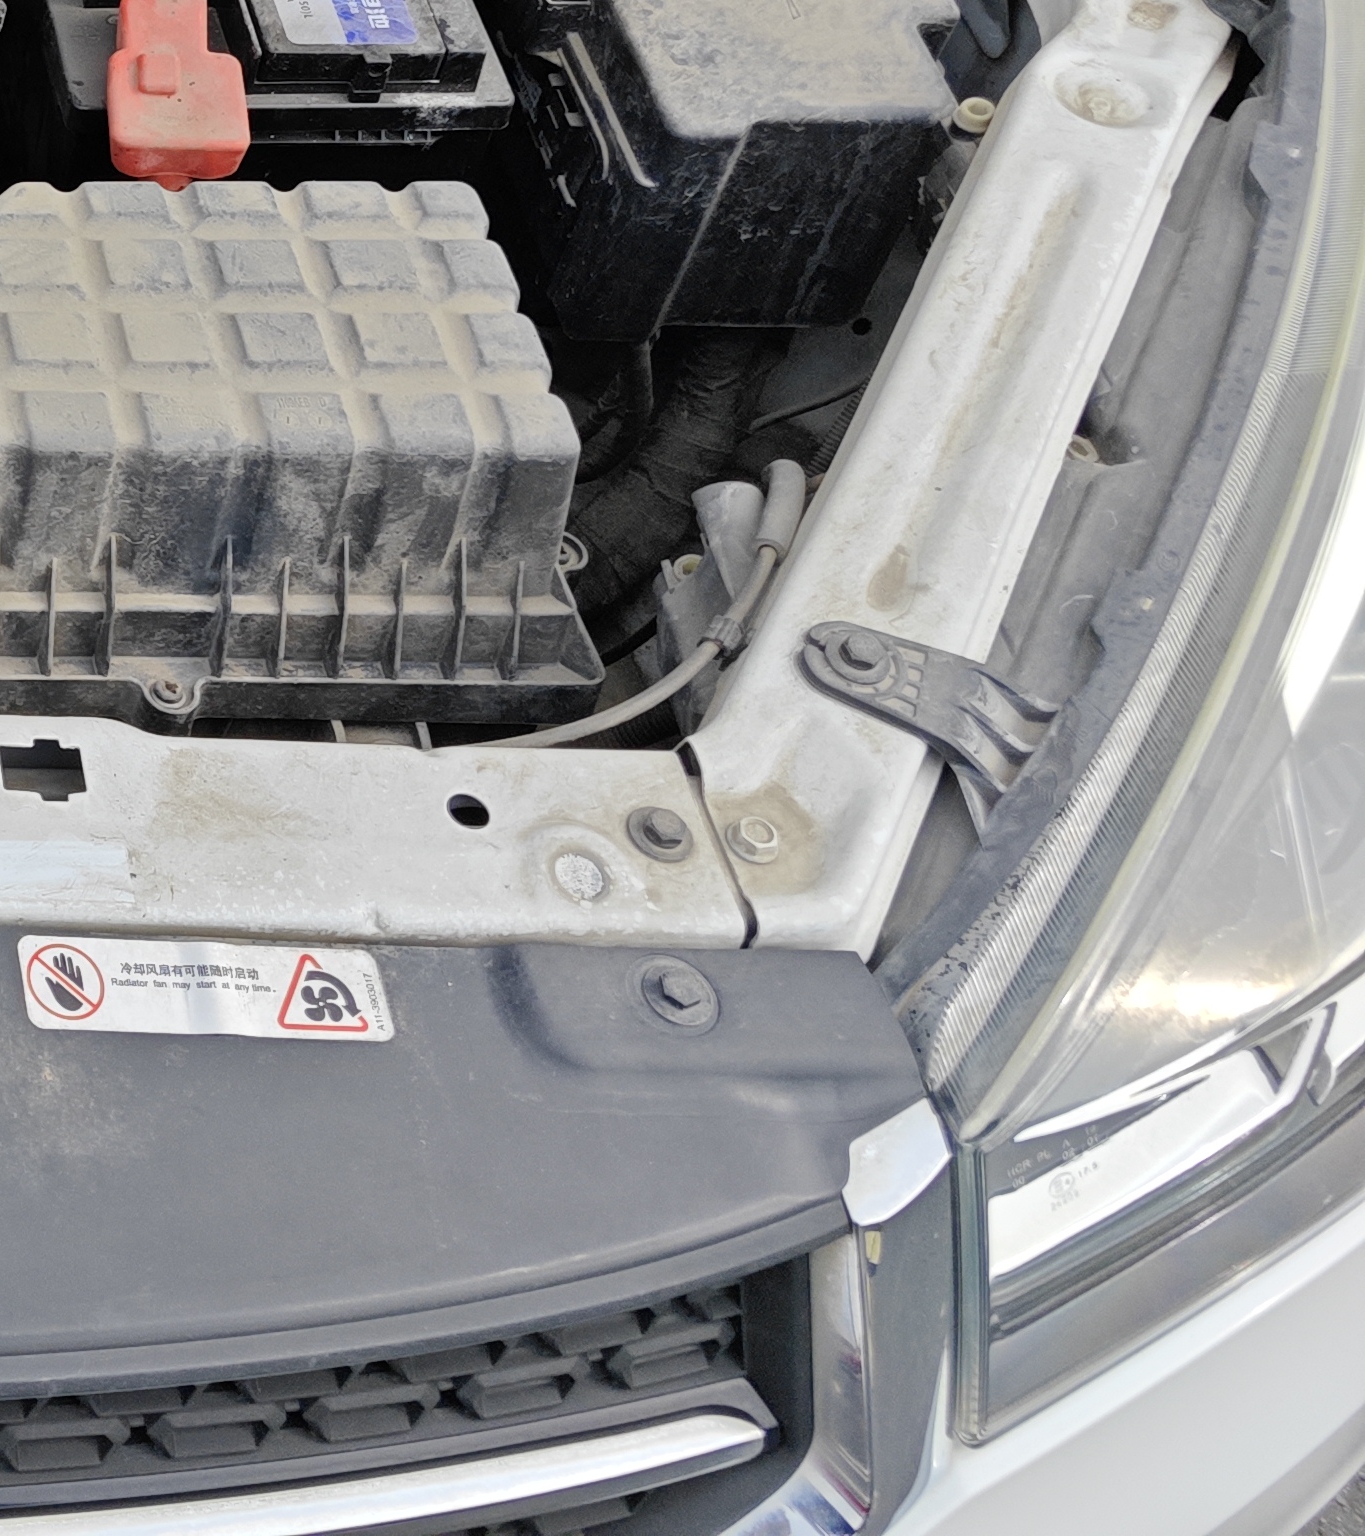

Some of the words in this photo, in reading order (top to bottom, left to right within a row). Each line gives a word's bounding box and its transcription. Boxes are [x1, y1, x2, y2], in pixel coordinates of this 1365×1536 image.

[111, 977, 149, 988] Radiator
[153, 978, 168, 989] fan
[172, 980, 191, 991] may
[196, 980, 217, 989] start
[222, 982, 231, 990] at
[235, 982, 250, 994] any
[250, 982, 277, 994] time.
[363, 972, 385, 1031] A11-3903017
